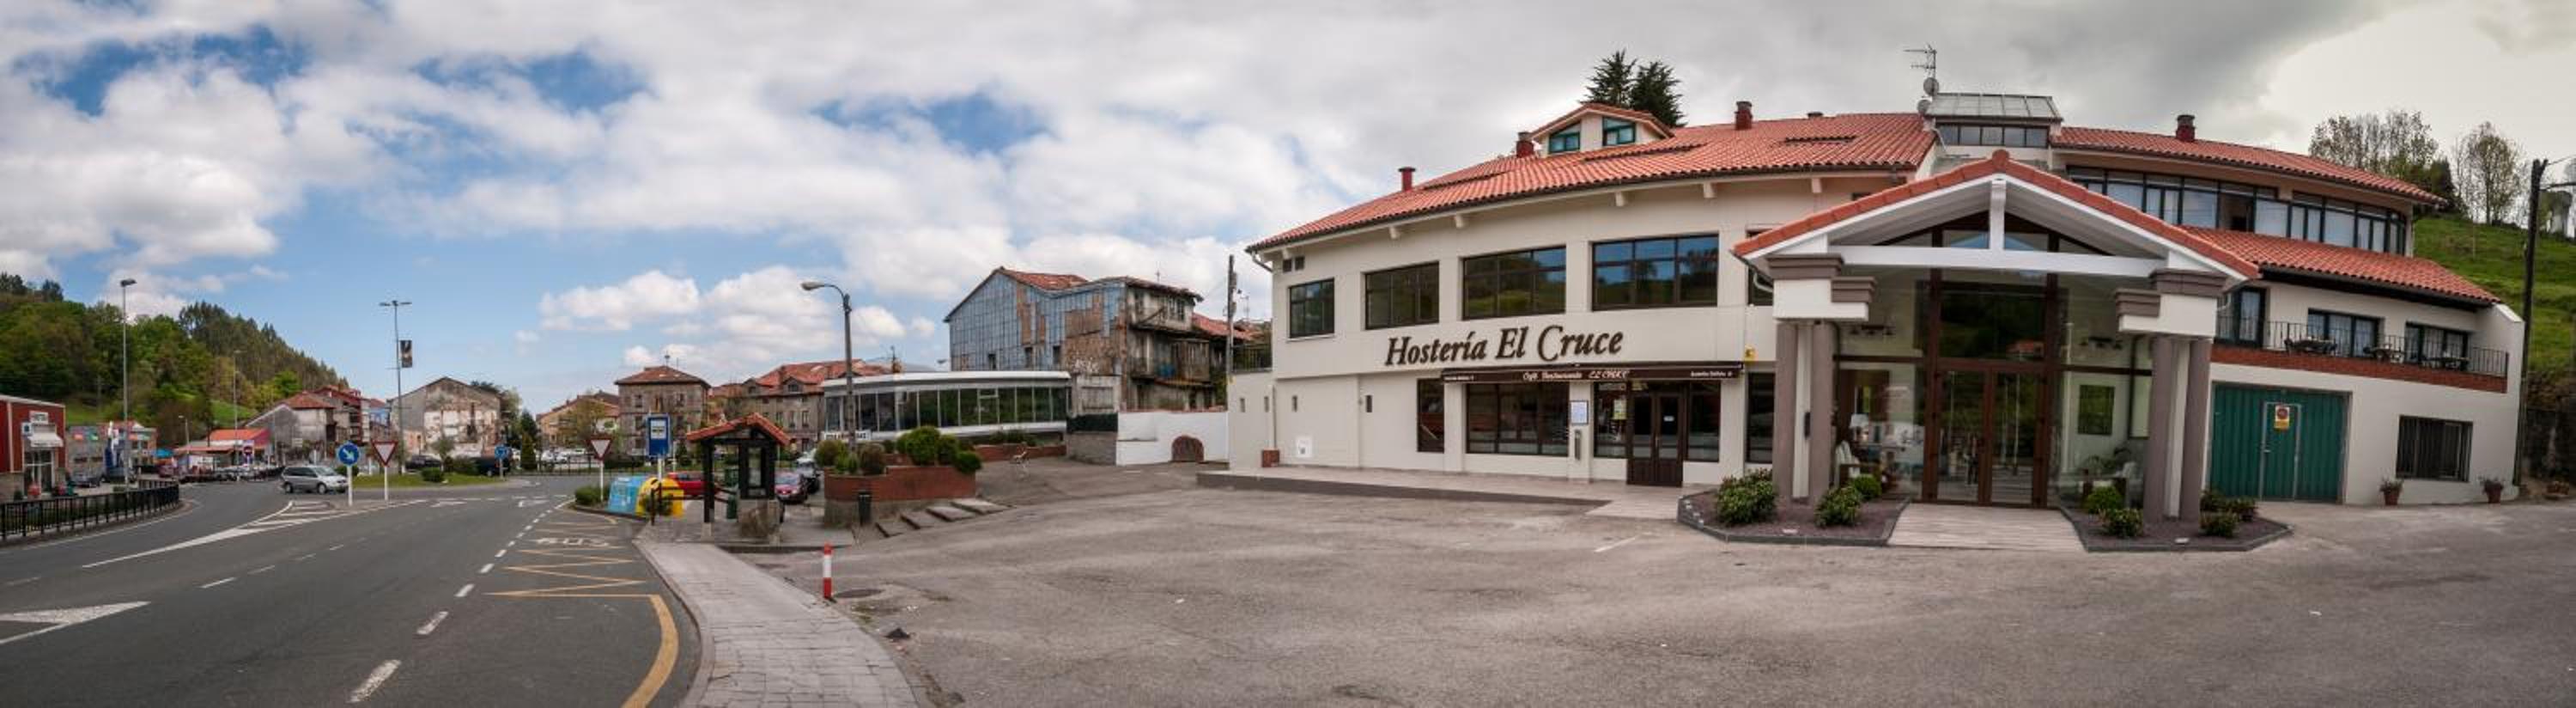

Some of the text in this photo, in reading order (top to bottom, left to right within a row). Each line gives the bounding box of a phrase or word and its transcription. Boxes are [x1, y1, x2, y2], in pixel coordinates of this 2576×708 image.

[1385, 325, 1624, 366] Hostería El Cruce
